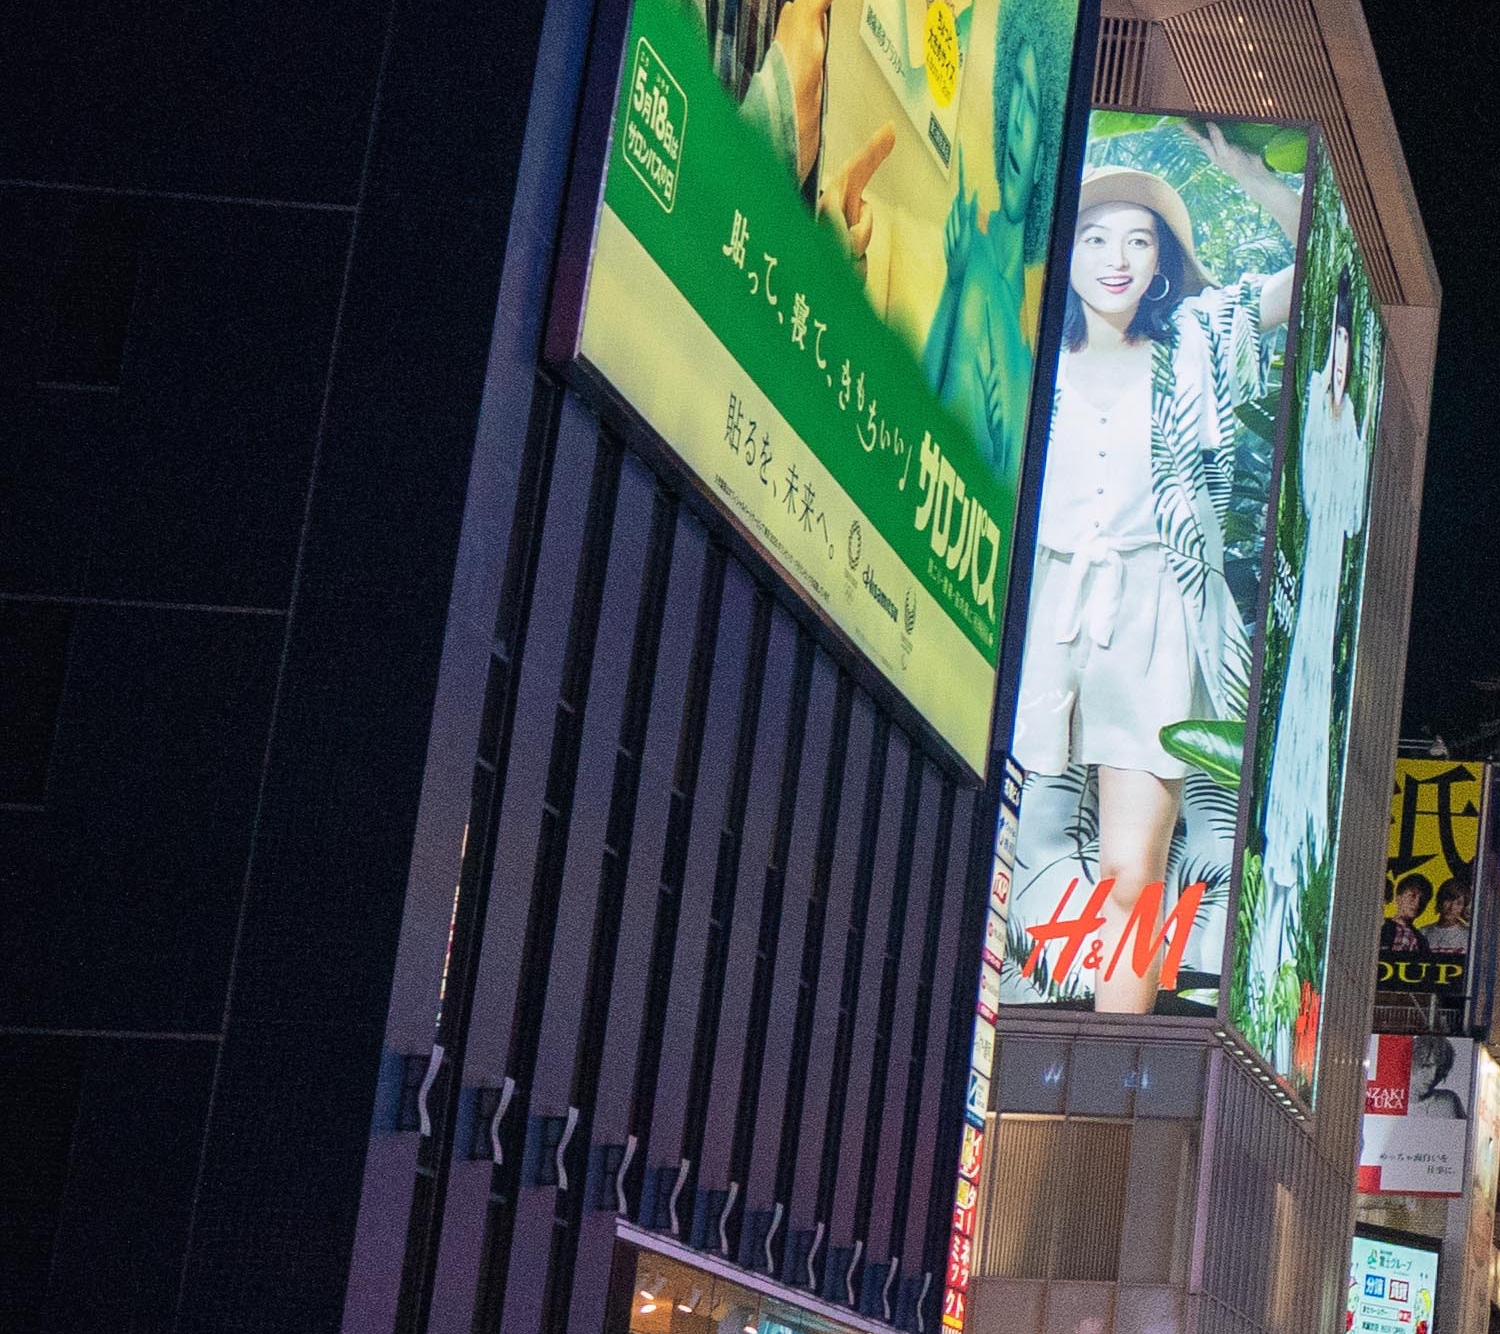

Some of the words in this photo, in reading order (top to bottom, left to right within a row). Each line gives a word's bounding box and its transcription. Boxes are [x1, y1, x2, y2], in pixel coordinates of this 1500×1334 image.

[627, 120, 675, 202] サロンパスの日
[632, 64, 679, 161] 5月18日は
[724, 391, 837, 561] 貼るを、未来へ。
[913, 430, 1000, 625] サロンパス
[1022, 877, 1206, 991] H&M
